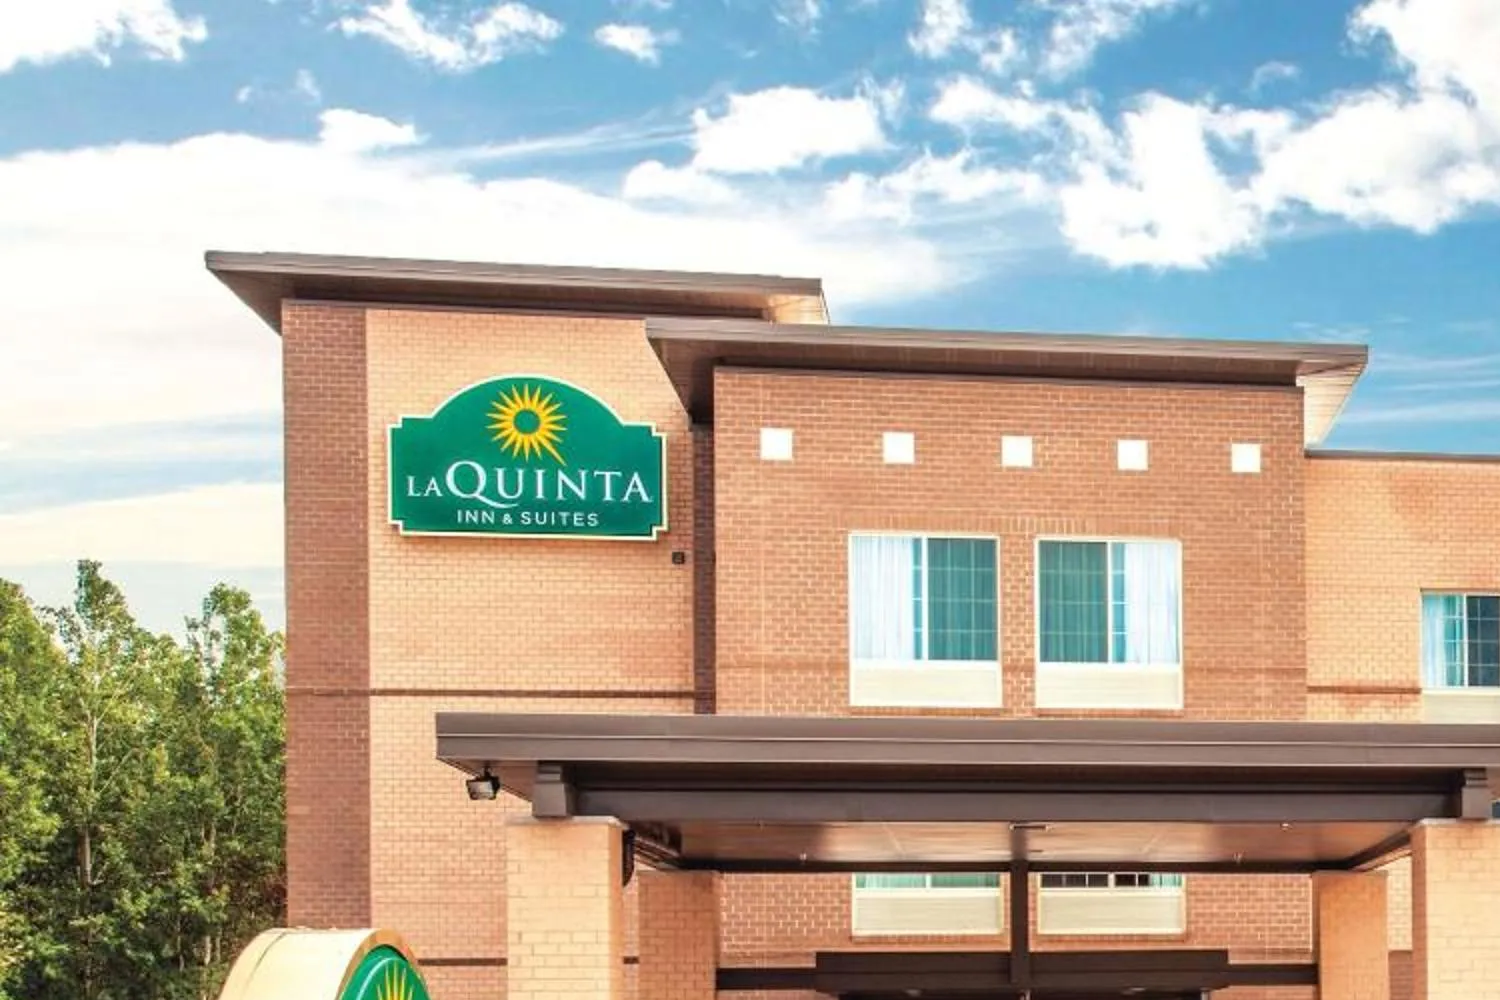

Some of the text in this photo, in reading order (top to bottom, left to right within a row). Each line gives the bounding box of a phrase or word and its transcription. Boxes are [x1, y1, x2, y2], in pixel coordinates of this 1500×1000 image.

[406, 460, 652, 509] LA QUINTA
[457, 510, 599, 527] INN & SUITES
